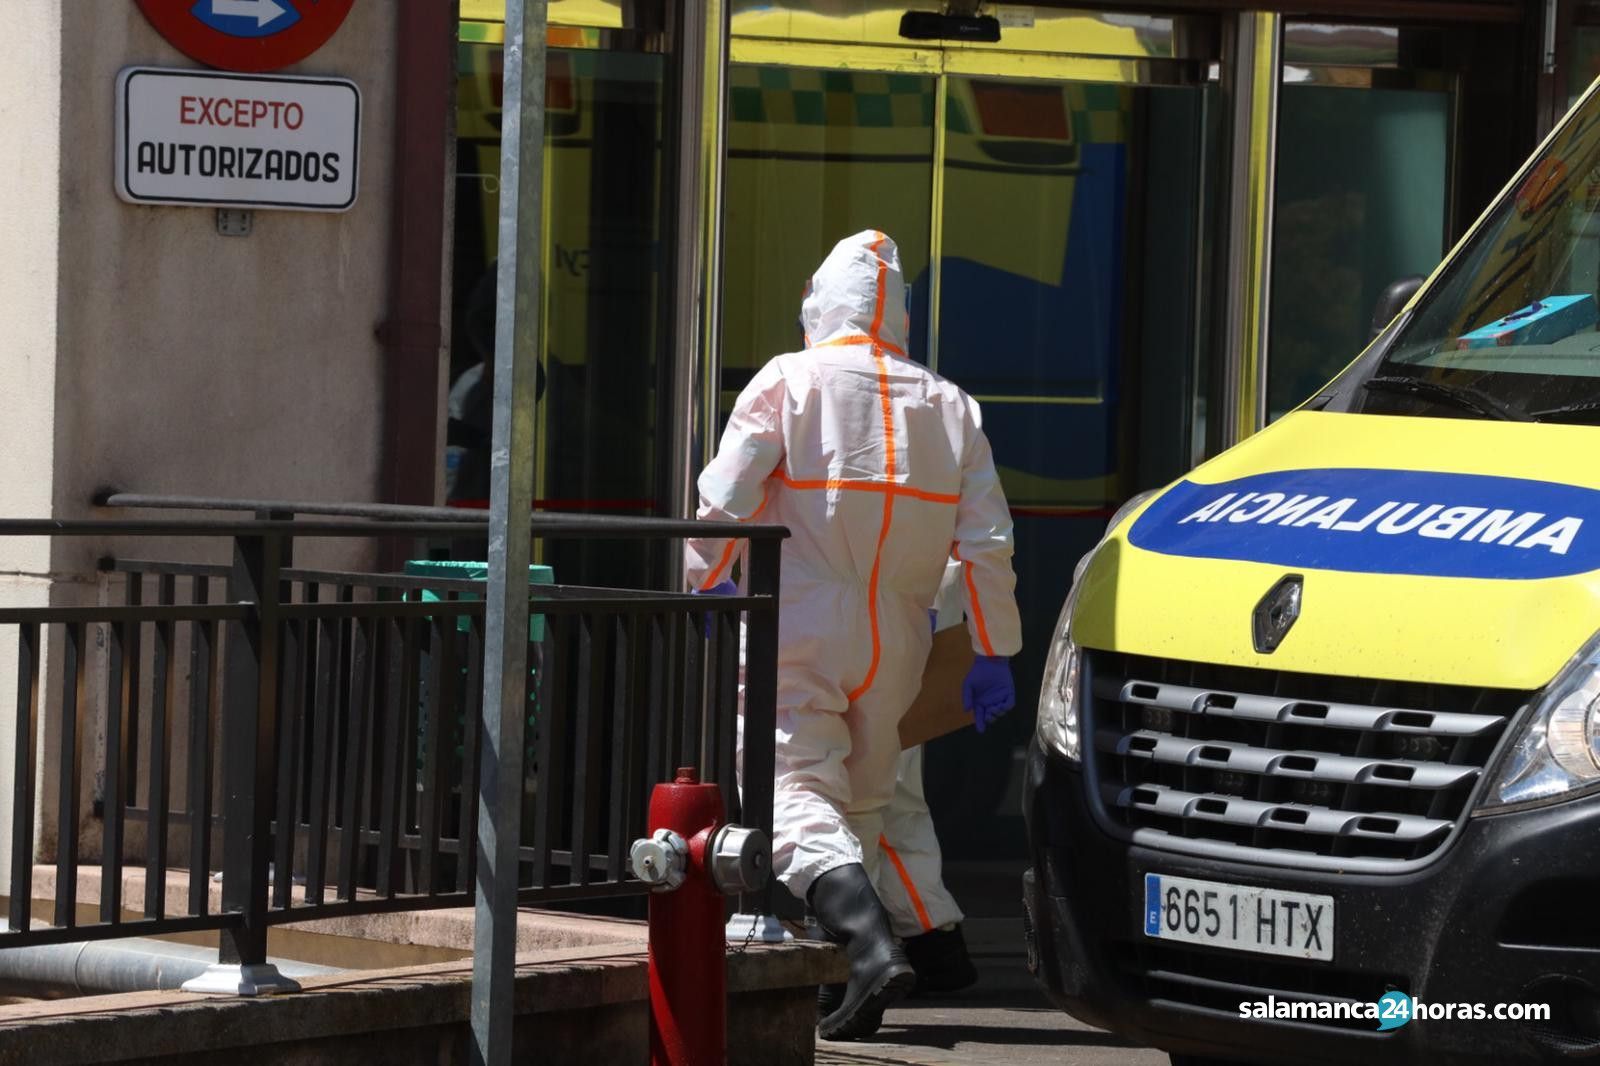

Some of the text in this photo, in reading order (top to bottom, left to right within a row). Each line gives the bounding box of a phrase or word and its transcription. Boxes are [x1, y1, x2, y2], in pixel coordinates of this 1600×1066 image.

[179, 96, 303, 130] EXCEPTO
[137, 141, 340, 183] AUTORIZADOS
[1150, 911, 1157, 924] E
[1166, 886, 1323, 951] 6651 HTX
